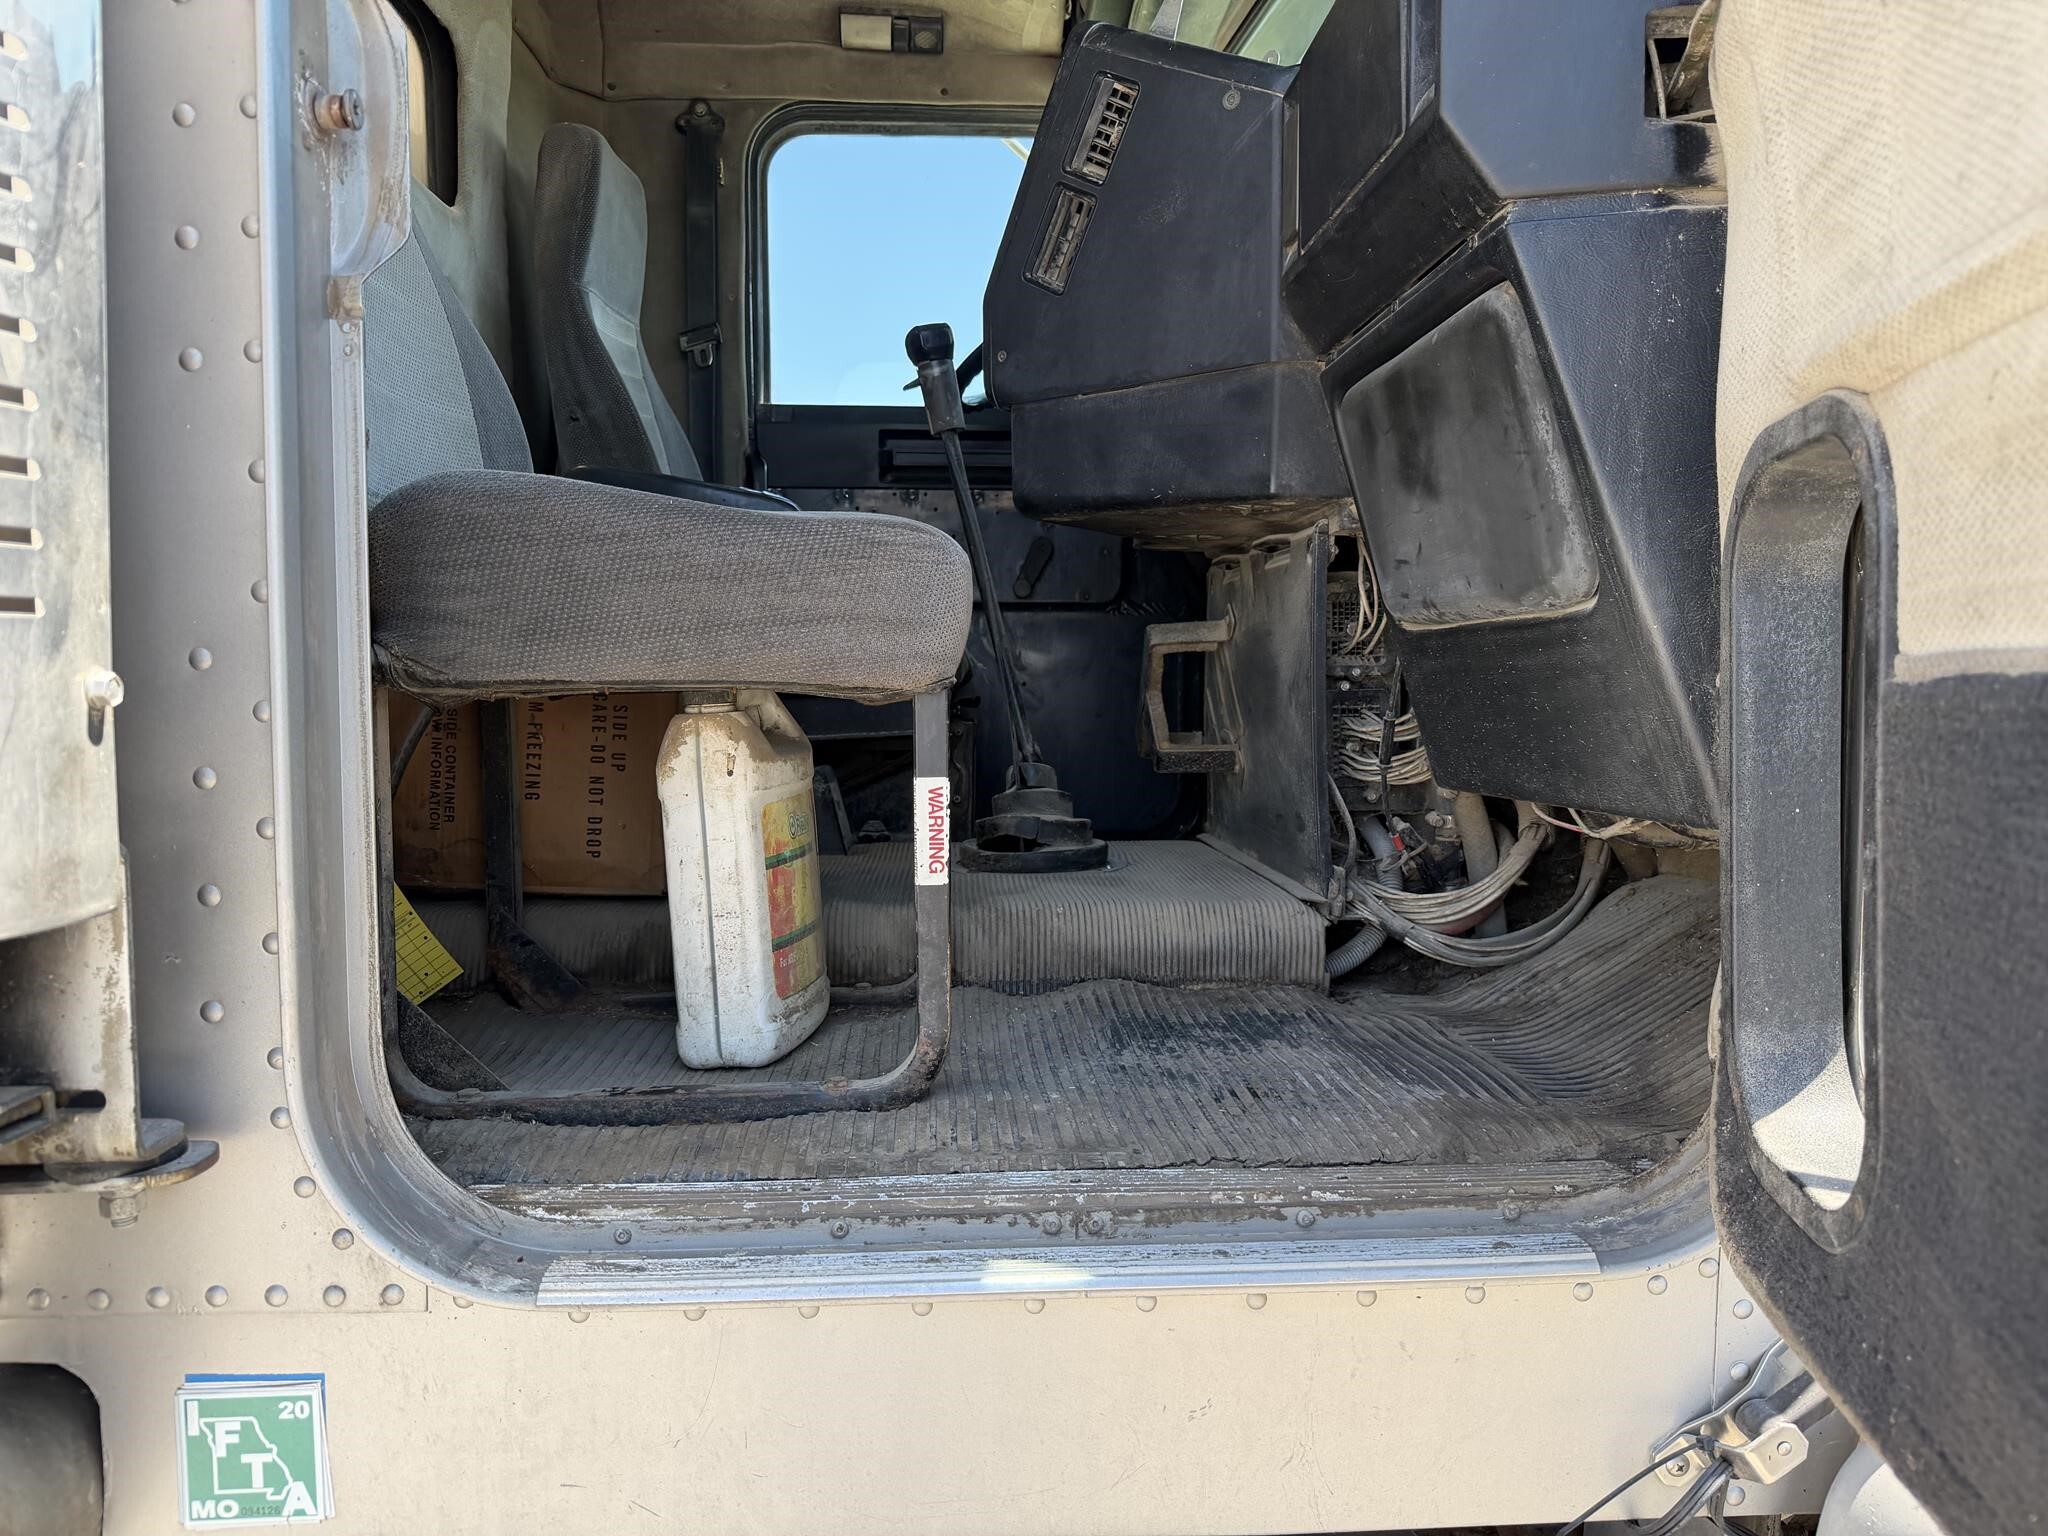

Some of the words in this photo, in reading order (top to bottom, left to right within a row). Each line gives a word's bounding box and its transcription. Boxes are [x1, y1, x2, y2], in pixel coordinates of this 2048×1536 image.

[446, 708, 458, 740] SIDE
[611, 704, 628, 742] SIDE
[611, 752, 626, 773] UP
[428, 737, 442, 832] INFORMATION
[443, 745, 456, 823] CONTAINER
[588, 776, 605, 806] NOT
[586, 816, 602, 859] DROP
[927, 786, 945, 874] WARNING
[278, 1400, 310, 1420] 20
[191, 1499, 240, 1519] MO
